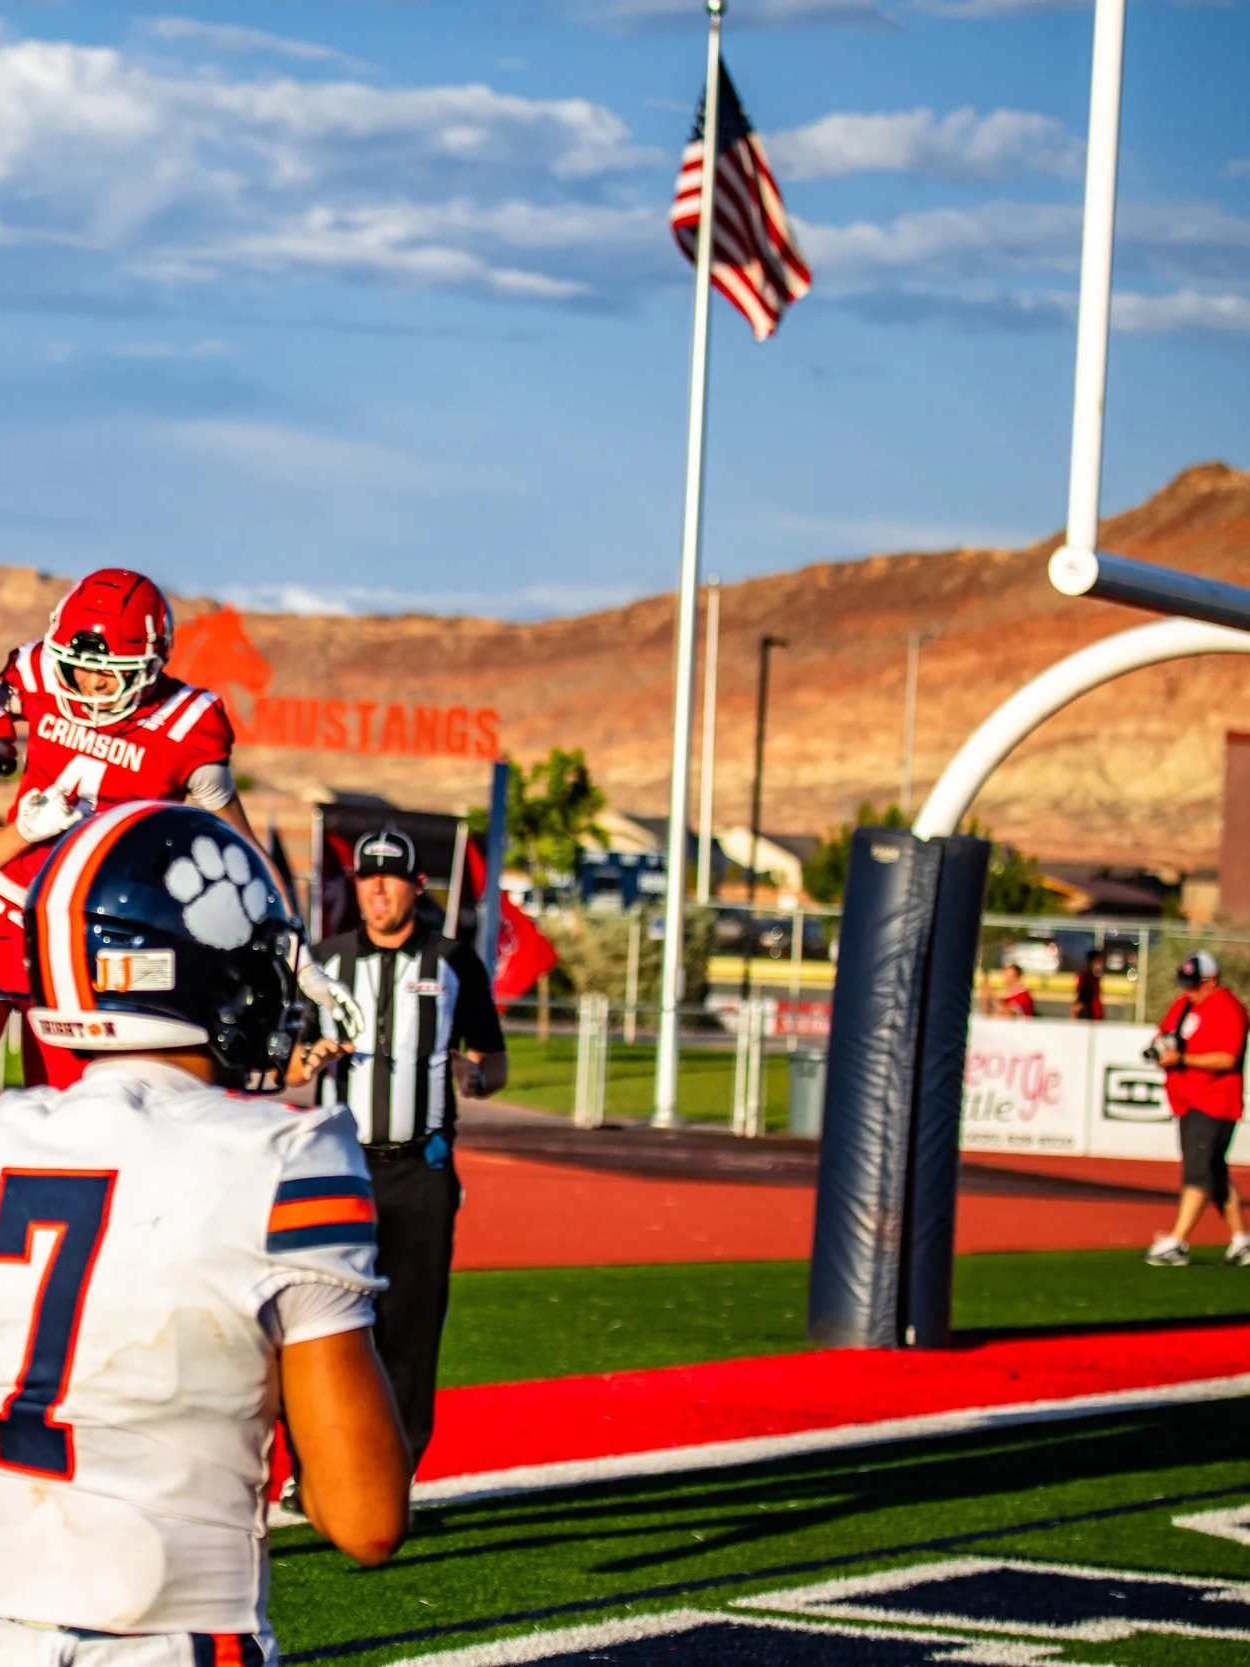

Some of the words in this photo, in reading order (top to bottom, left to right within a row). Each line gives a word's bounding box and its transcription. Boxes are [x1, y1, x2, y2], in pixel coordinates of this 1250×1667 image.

[37, 713, 146, 773] CRIMSON
[253, 697, 500, 760] MUSTANGS
[964, 1052, 1062, 1124] eorge
